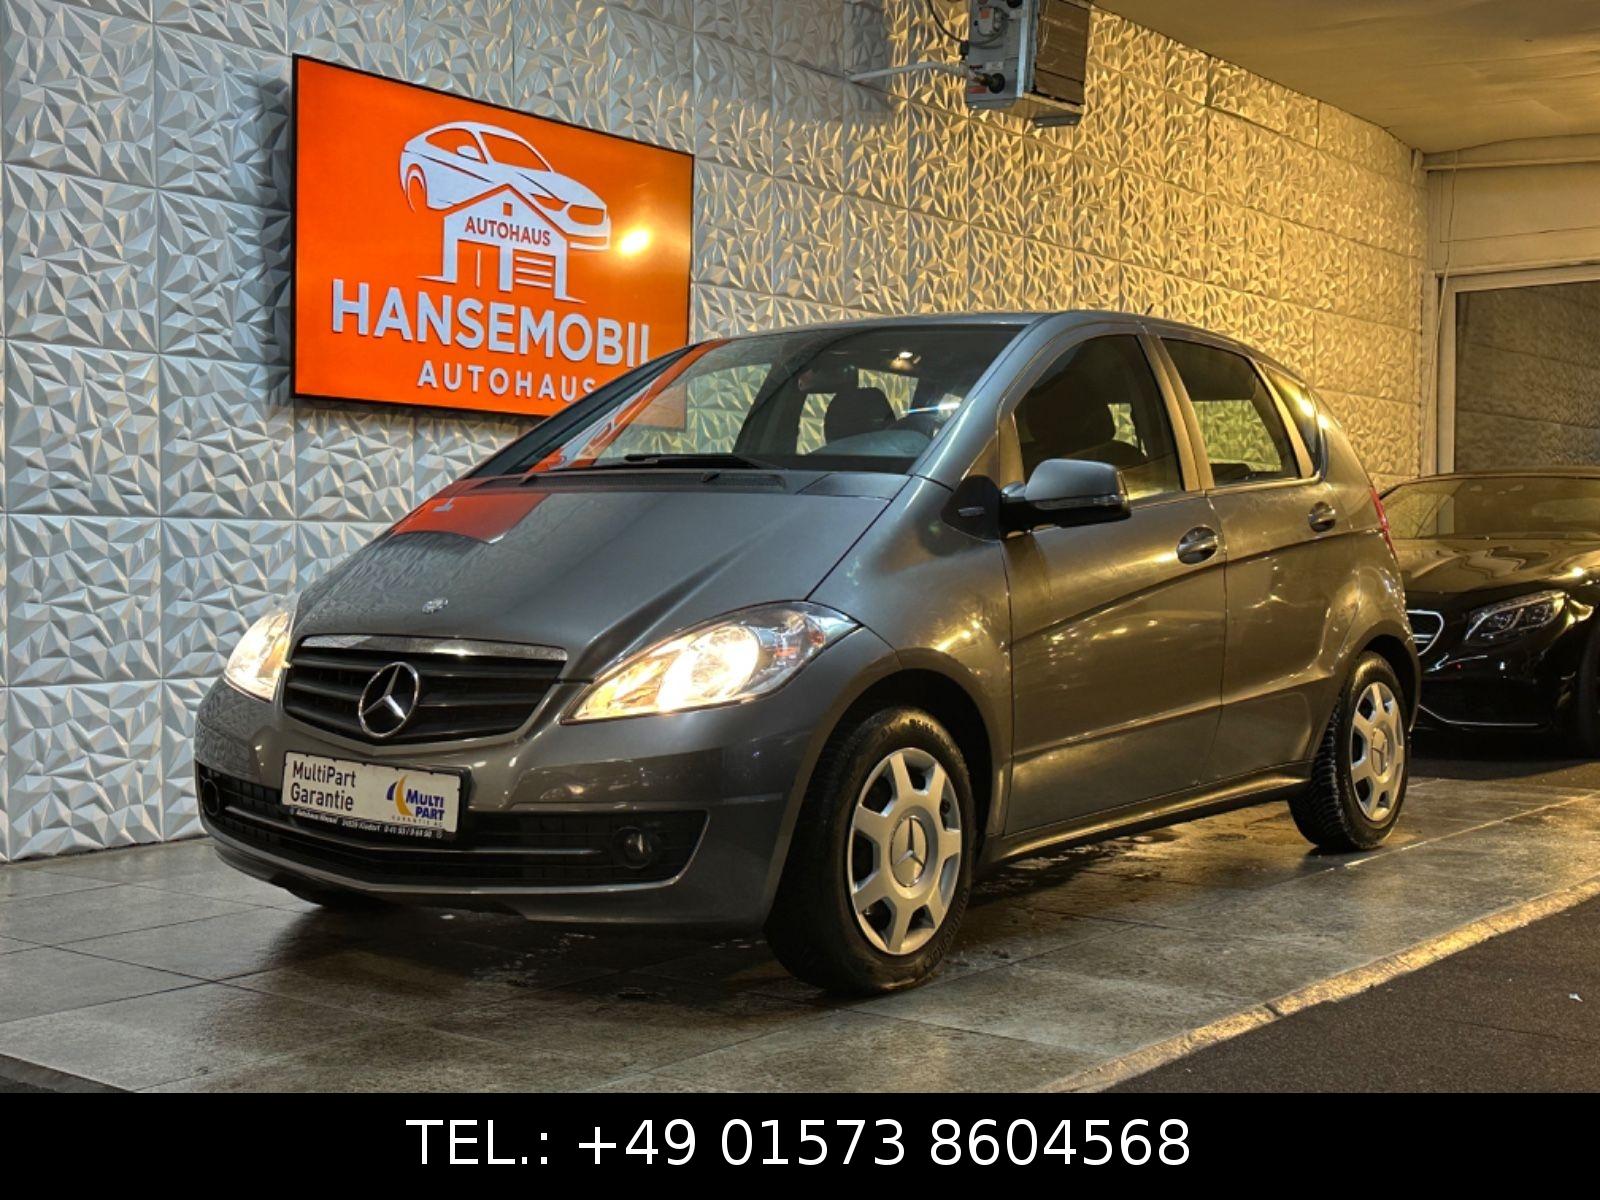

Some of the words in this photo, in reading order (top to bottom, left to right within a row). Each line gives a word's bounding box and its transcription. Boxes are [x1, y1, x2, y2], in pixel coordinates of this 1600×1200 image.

[464, 216, 552, 247] AUTOHAUS
[292, 760, 357, 788] MultiPart
[290, 782, 355, 812] Garantie
[406, 788, 444, 808] MULTI
[415, 806, 445, 821] PART
